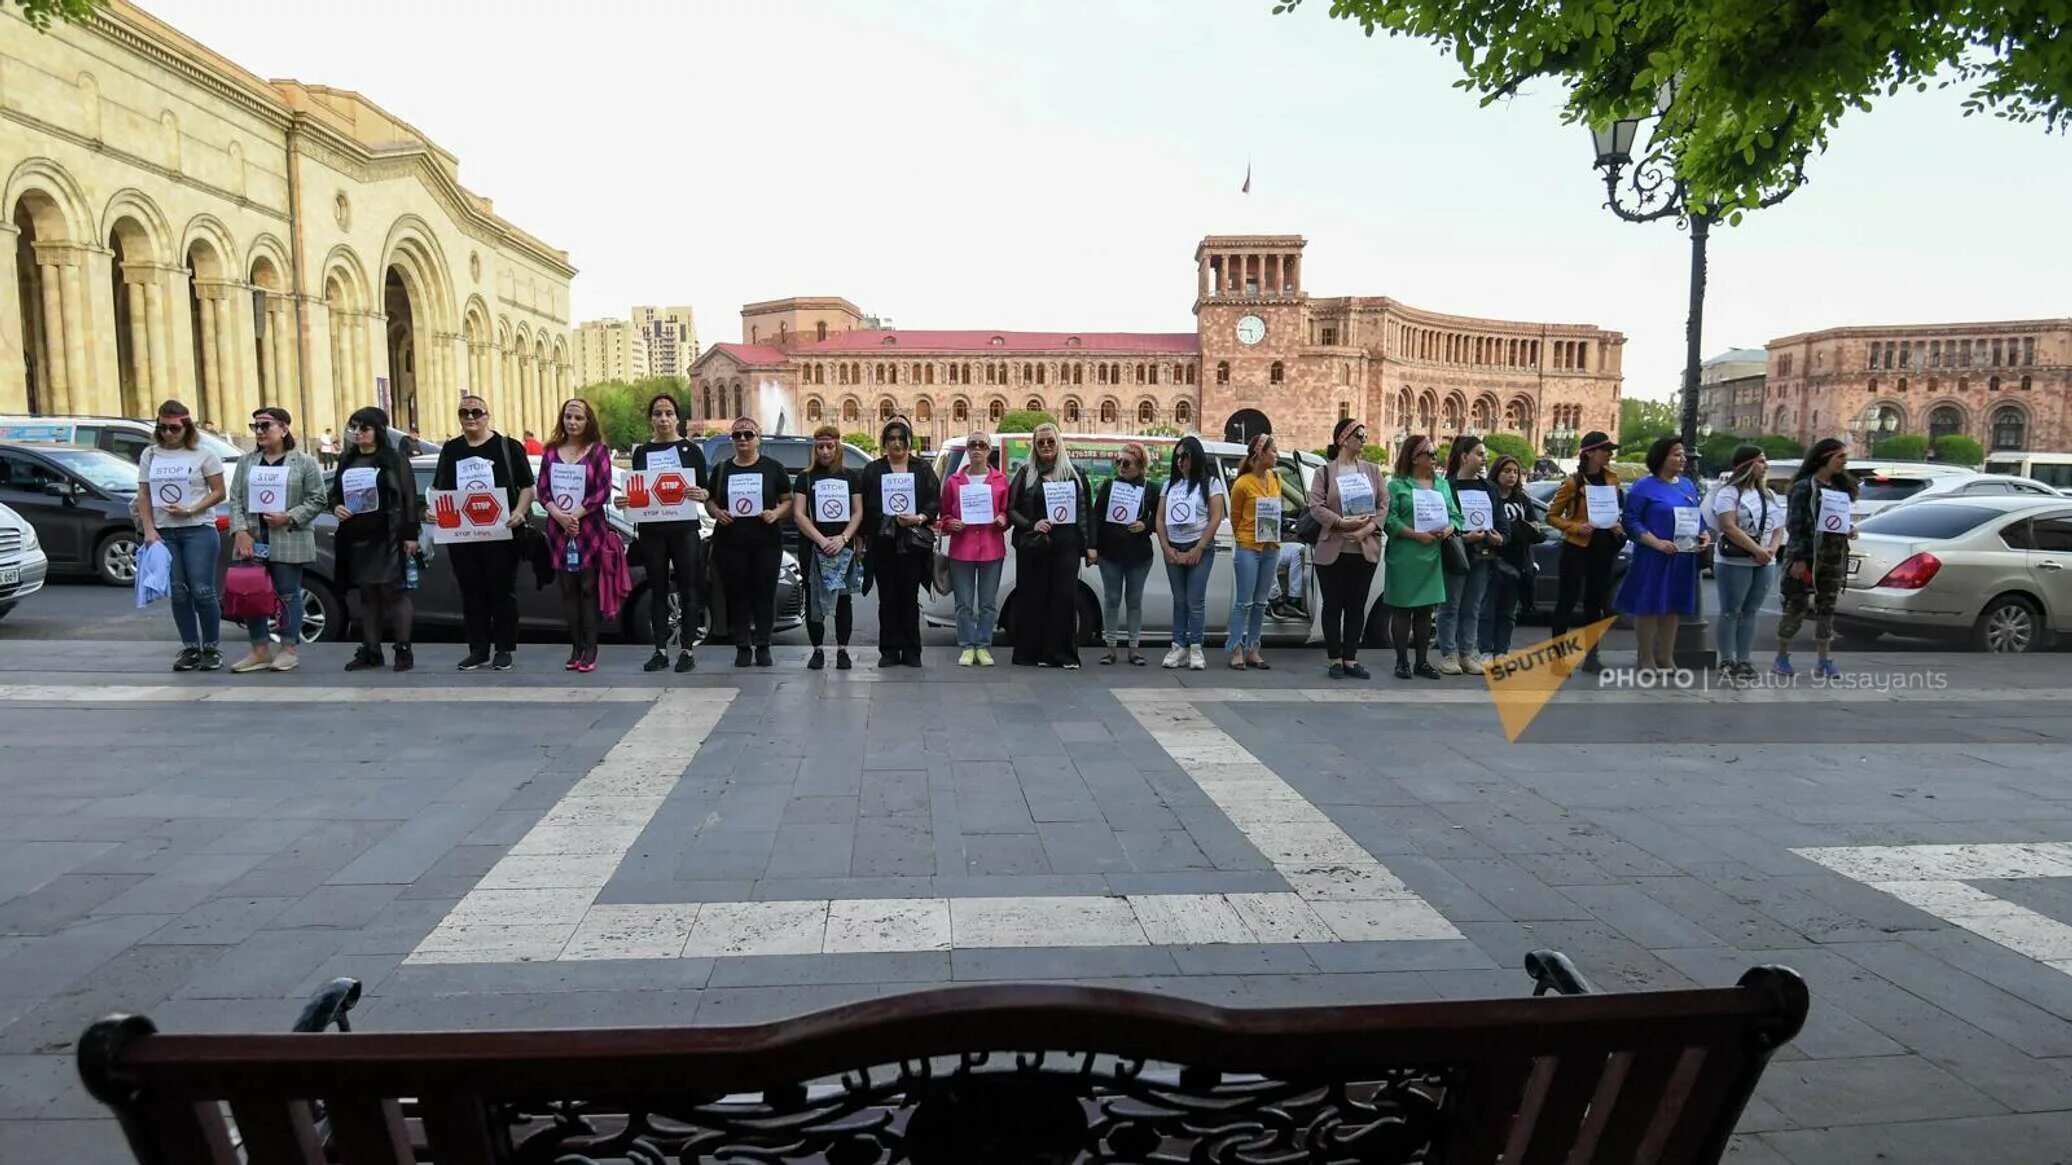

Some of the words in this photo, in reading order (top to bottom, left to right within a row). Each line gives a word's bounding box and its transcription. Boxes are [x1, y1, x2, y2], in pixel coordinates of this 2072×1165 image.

[156, 466, 185, 475] STOP
[462, 463, 488, 473] STOP
[257, 473, 280, 482] STOP
[886, 477, 911, 485] STOP
[661, 481, 680, 490] STOP
[820, 483, 845, 491] STOP
[471, 502, 491, 511] STOP
